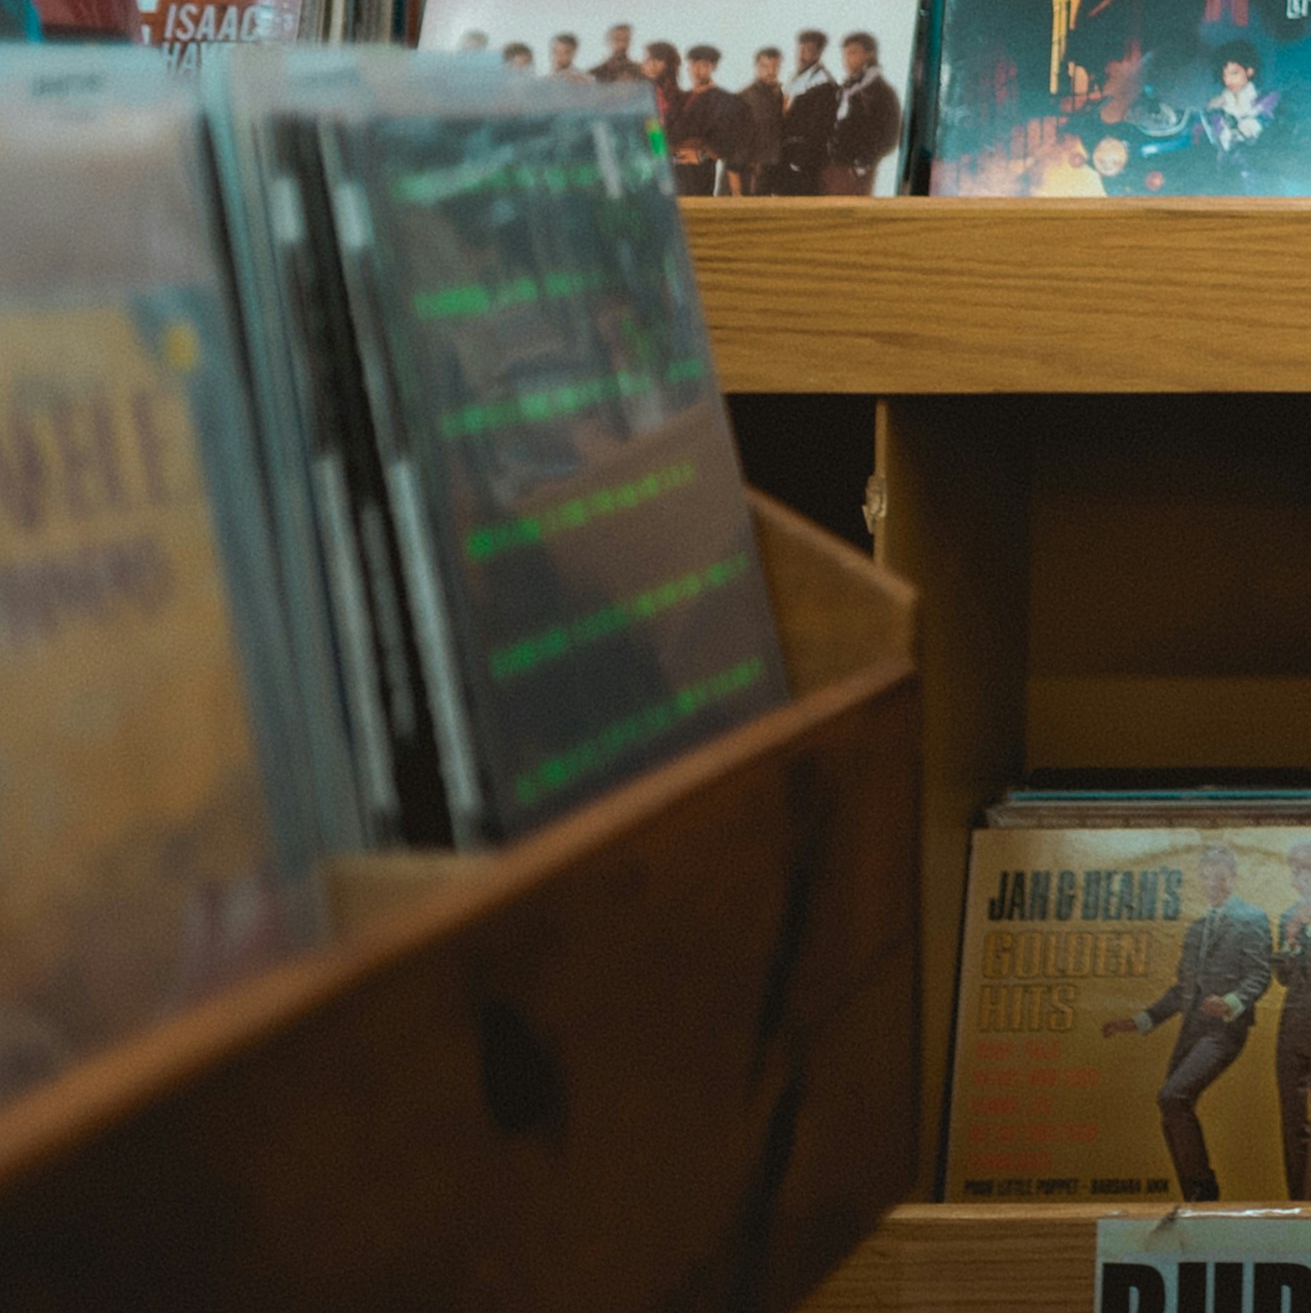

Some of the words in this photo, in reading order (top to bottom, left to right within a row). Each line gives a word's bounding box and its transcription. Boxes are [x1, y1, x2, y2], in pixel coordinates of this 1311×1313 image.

[164, 2, 262, 39] ISAAC
[988, 869, 1052, 921] JAN
[982, 931, 1150, 979] GOLDEN
[977, 984, 1077, 1032] HITS
